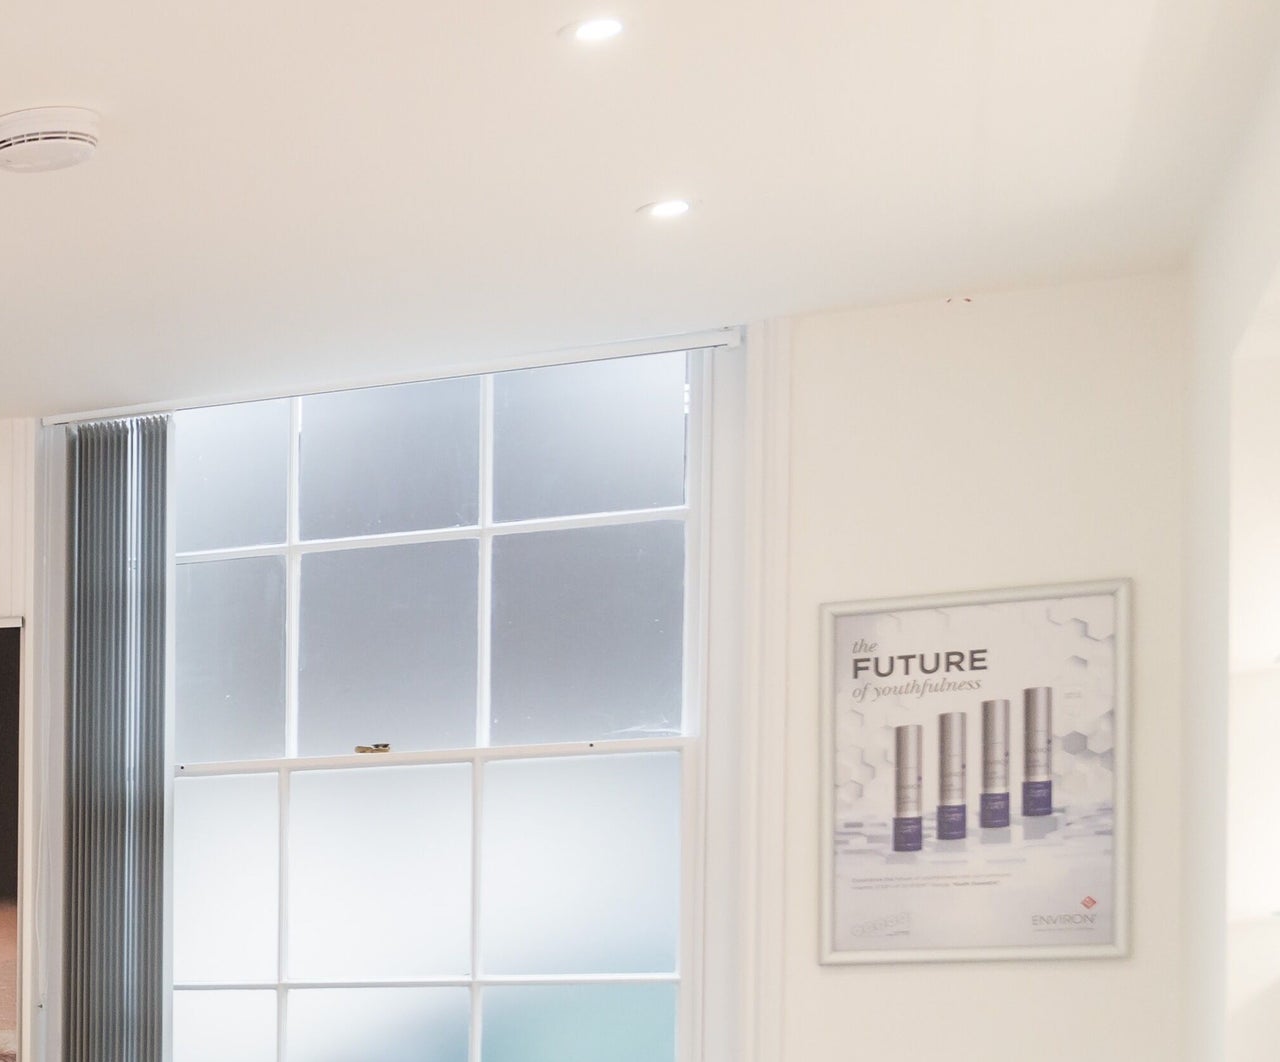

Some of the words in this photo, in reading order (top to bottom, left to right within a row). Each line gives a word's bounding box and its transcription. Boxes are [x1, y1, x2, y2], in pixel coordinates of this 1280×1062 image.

[852, 638, 878, 654] the
[852, 649, 989, 680] FUTURE
[852, 682, 871, 701] of
[873, 677, 983, 702] youthfulness
